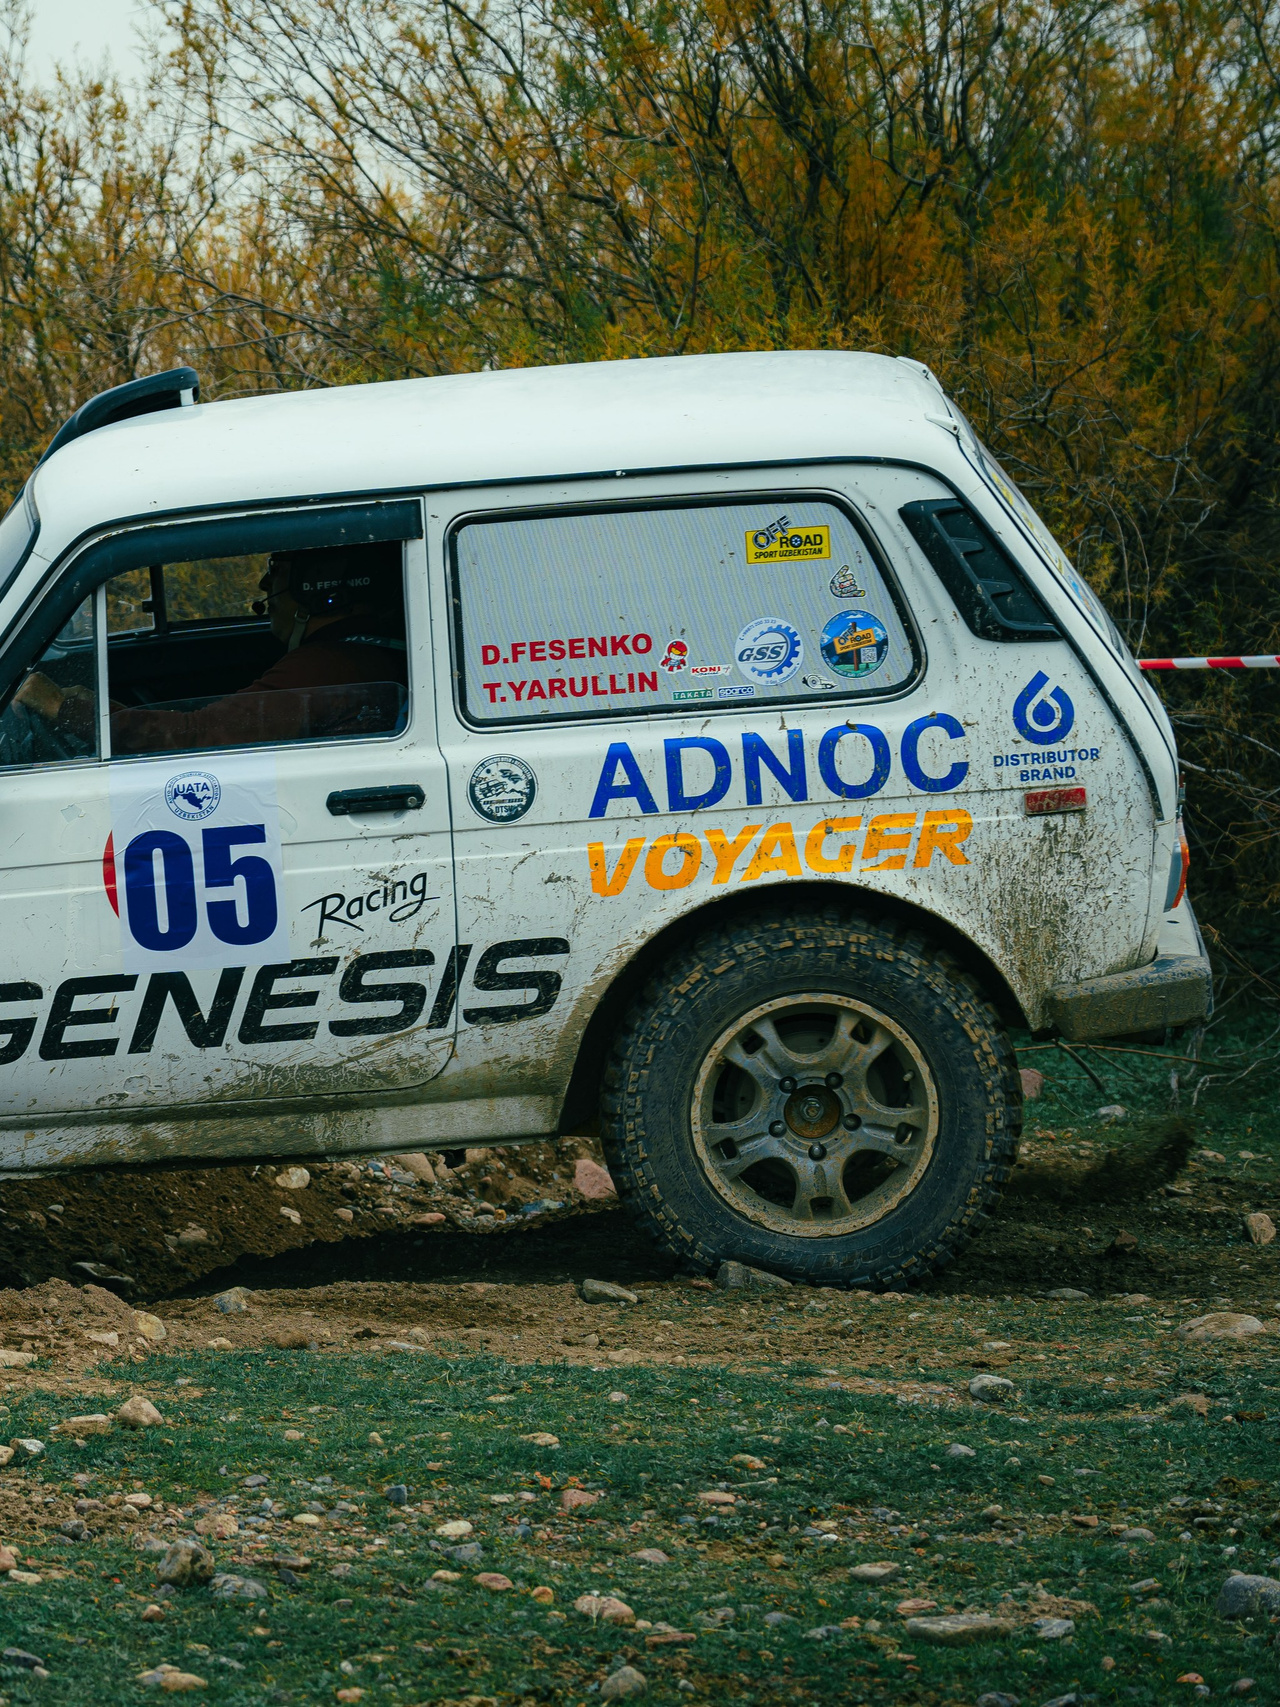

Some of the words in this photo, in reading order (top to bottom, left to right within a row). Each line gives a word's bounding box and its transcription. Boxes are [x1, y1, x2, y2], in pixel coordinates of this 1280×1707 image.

[753, 515, 791, 549] OFF
[780, 534, 823, 548] ROAD
[754, 551, 778, 559] SPORT
[779, 548, 823, 557] UZBEKISTAN
[838, 626, 856, 646] OFF
[850, 633, 872, 644] ROAD
[481, 633, 652, 666] D.FESENKO
[738, 645, 785, 663] GSS
[691, 666, 721, 674] KONI
[483, 671, 658, 703] T.YARULLIN
[674, 690, 712, 699] TAKATA
[719, 686, 753, 697] sparco
[588, 712, 970, 818] ADNOC
[993, 748, 1100, 767] DISTRIBUTOR
[1020, 766, 1076, 781] BRAND
[177, 782, 210, 793] UATA
[174, 805, 214, 819] UZBEKISTAN
[587, 809, 973, 898] VOYAGER
[124, 824, 278, 951] 05
[301, 872, 440, 948] Racing
